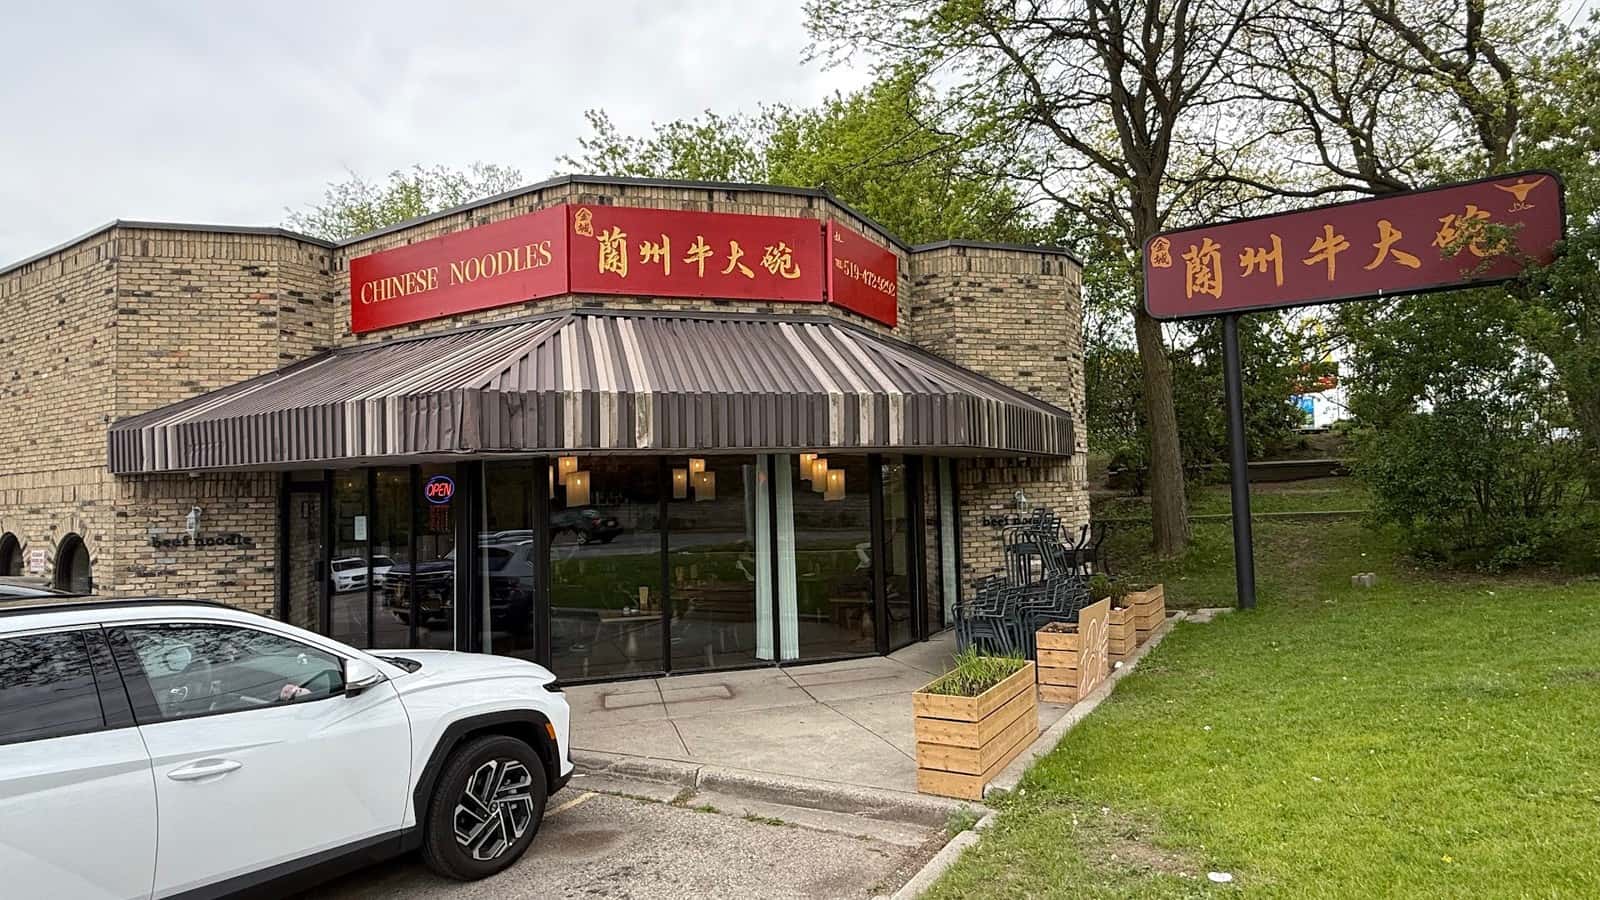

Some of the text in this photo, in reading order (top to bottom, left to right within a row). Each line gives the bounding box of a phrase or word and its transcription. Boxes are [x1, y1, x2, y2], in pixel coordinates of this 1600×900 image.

[596, 226, 801, 278] 蘭州牛大碗
[360, 240, 552, 304] CHINESE NOODLES
[426, 482, 452, 497] OPEN
[152, 533, 253, 547] beef noodle
